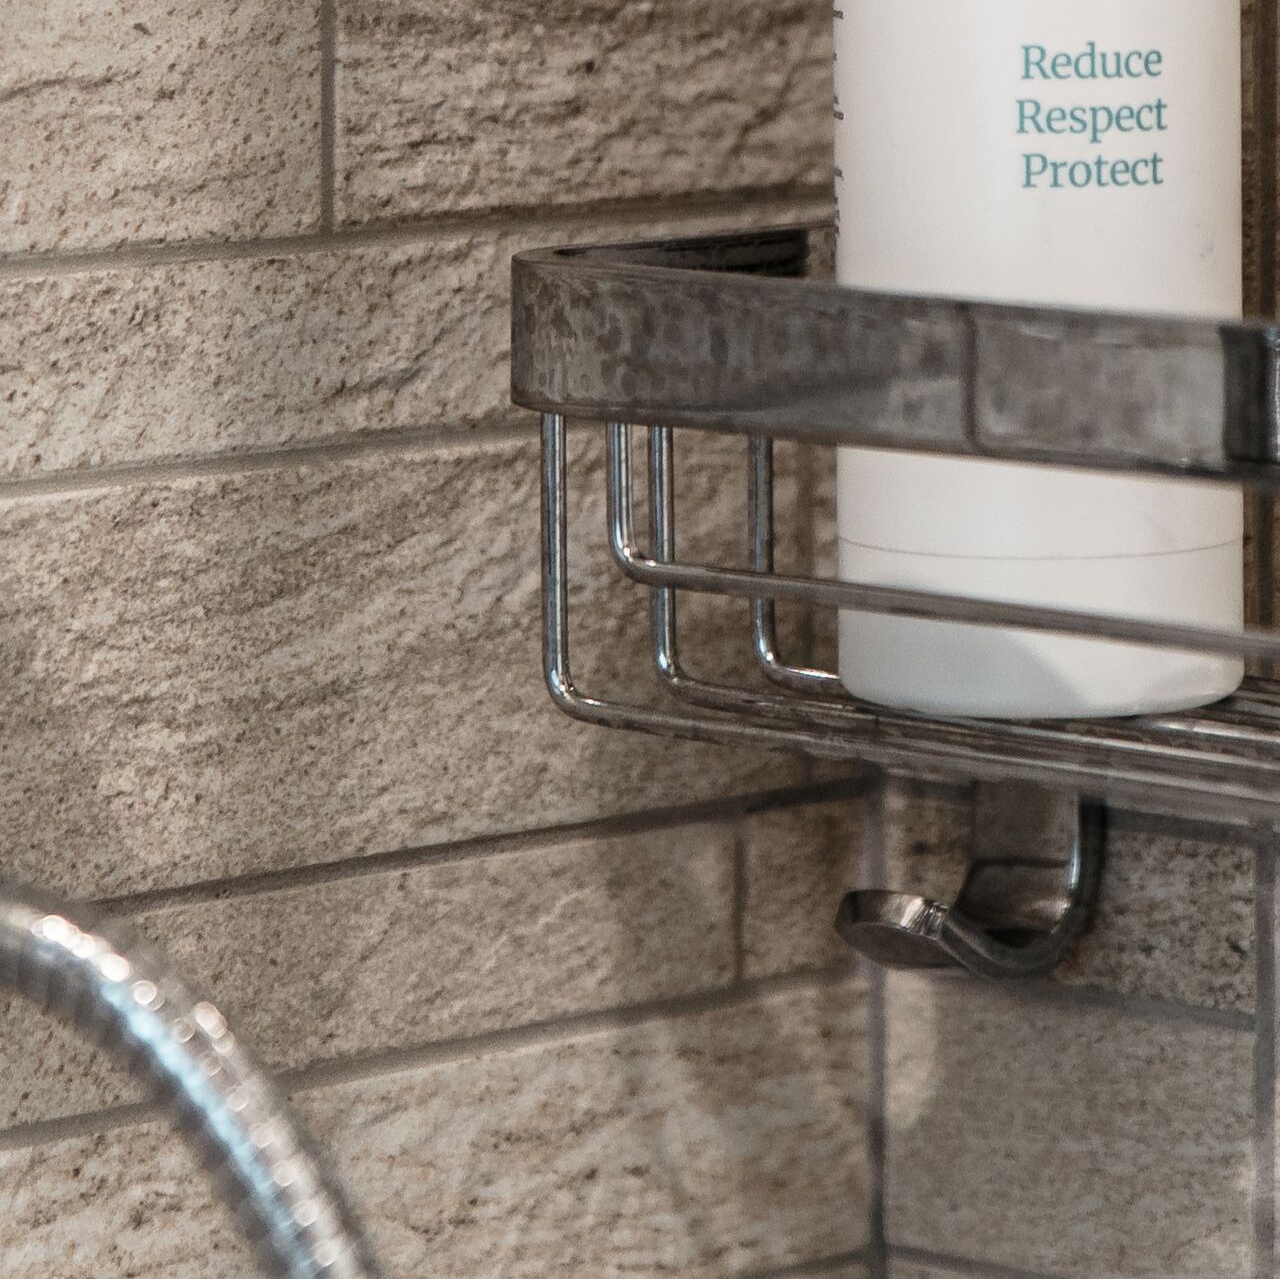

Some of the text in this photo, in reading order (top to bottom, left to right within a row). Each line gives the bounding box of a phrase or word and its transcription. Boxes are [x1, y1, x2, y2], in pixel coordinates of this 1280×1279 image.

[1021, 41, 1162, 80] Reduce
[1016, 98, 1168, 143] Respect
[1022, 152, 1164, 188] Protect
